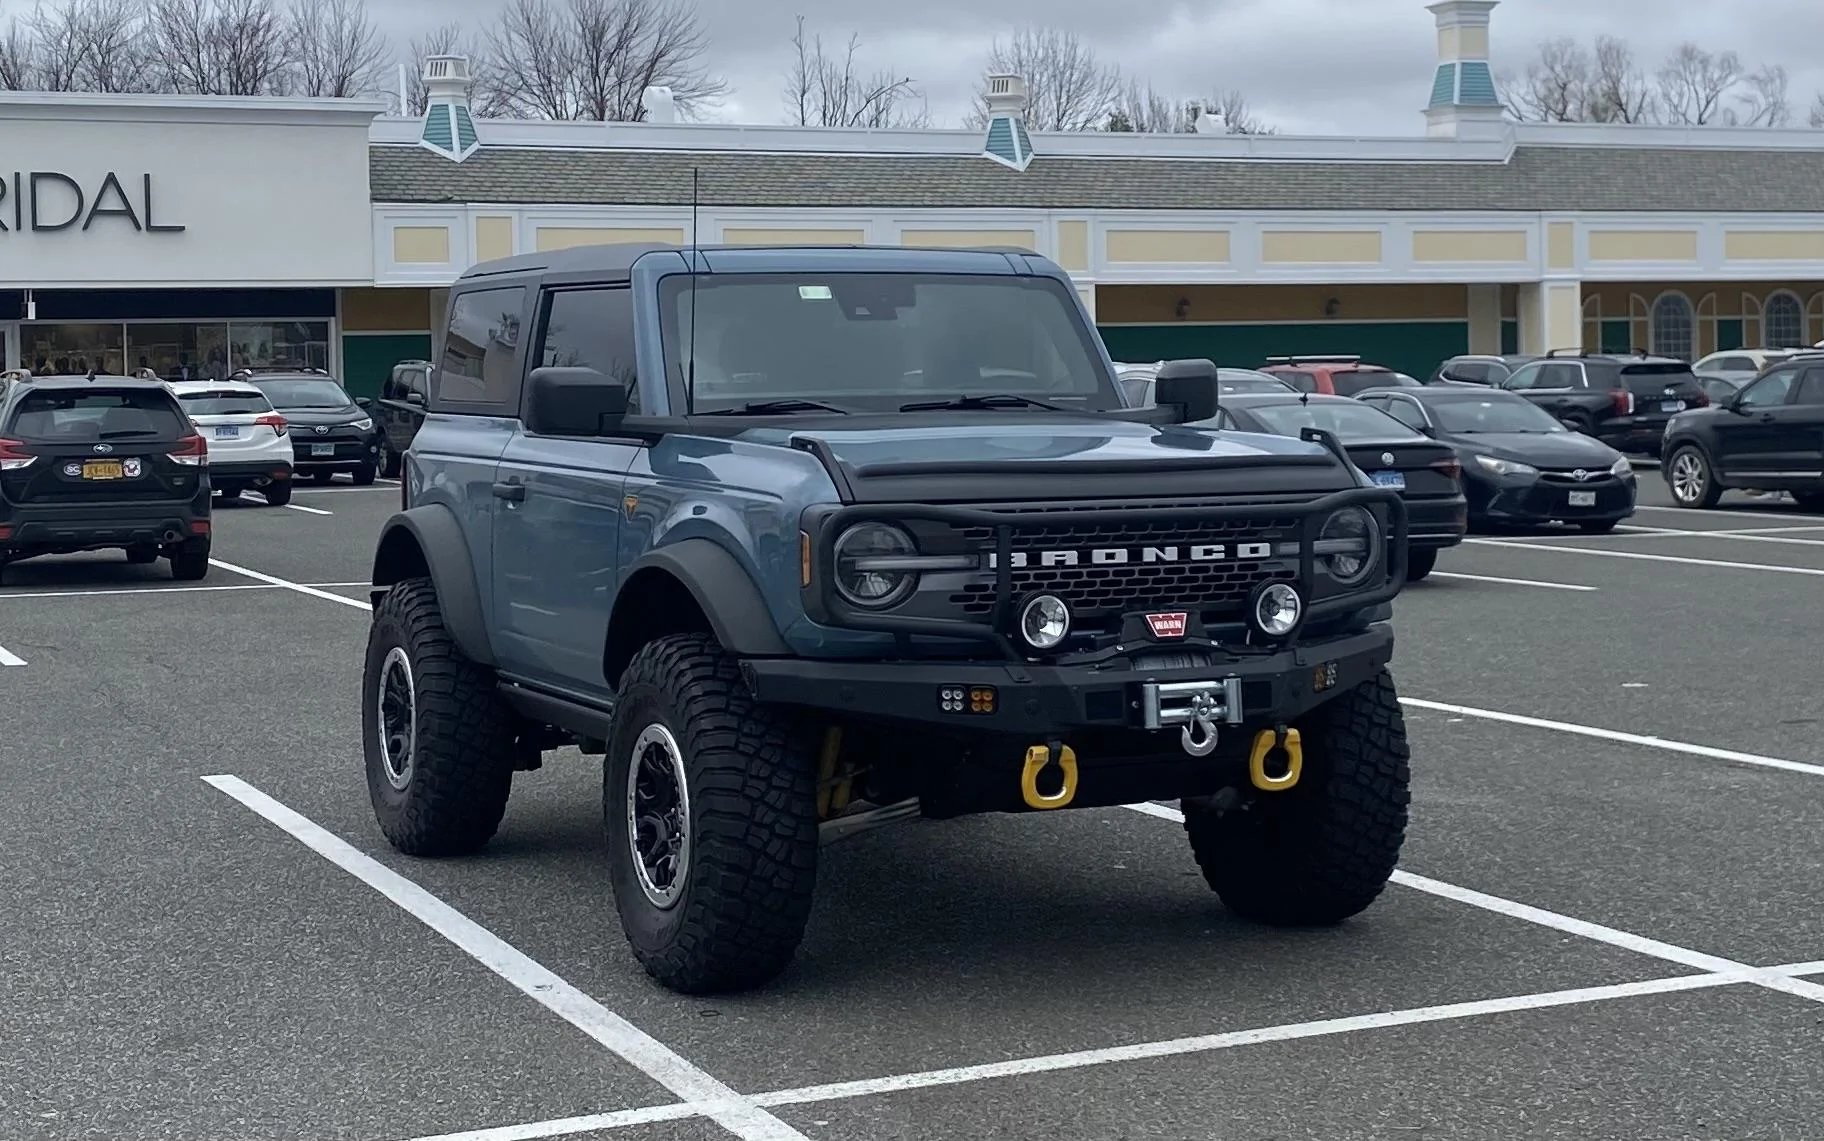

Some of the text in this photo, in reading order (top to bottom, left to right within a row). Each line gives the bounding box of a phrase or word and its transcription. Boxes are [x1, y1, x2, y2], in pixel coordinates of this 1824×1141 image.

[0, 171, 186, 232] IDAL
[989, 543, 1271, 568] BRONCO
[1154, 620, 1182, 630] WARN
